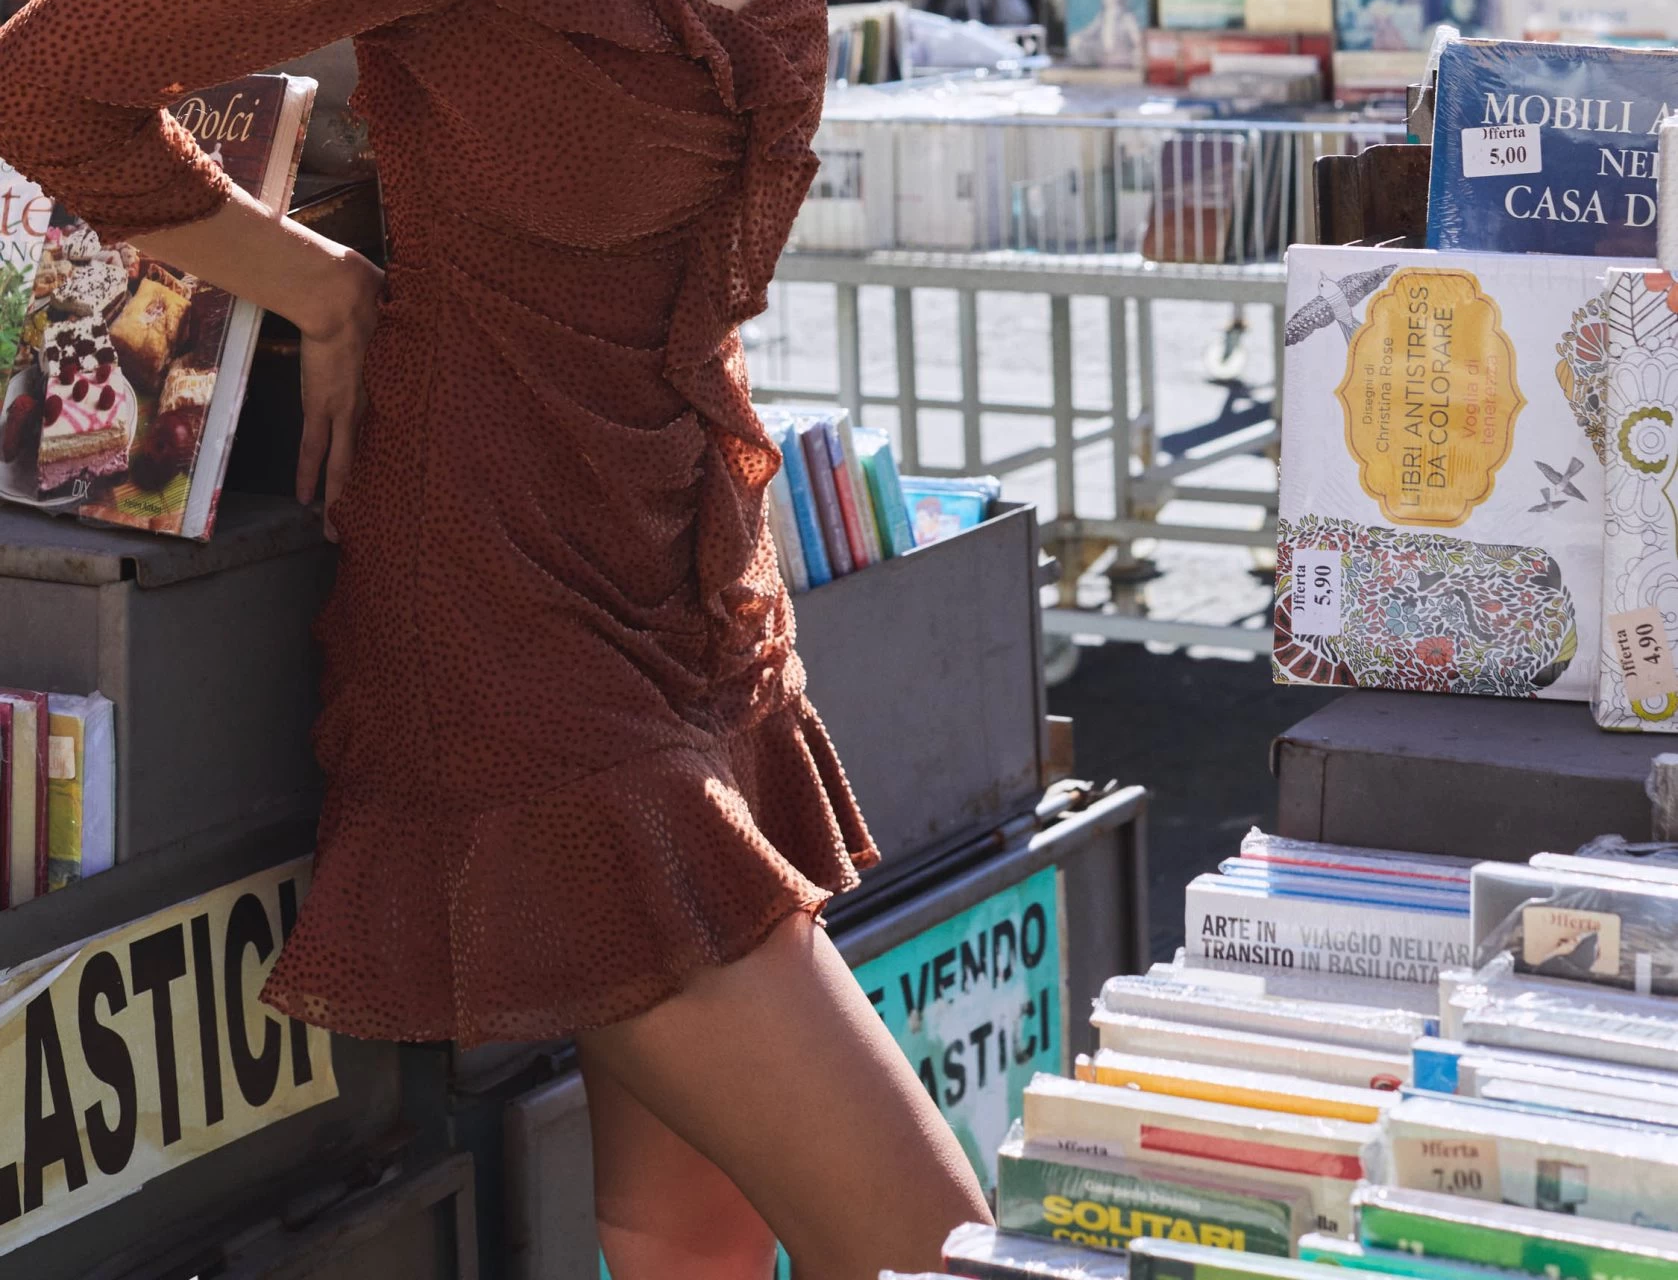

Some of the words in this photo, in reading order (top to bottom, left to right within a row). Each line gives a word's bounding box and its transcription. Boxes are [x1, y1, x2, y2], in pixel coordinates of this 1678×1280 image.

[175, 93, 261, 142] Dolci
[1481, 92, 1635, 134] MOBILI
[1489, 145, 1527, 168] 5,00
[1504, 185, 1608, 225] CASA
[1364, 363, 1375, 376] di
[1380, 337, 1394, 376] Rose
[1404, 286, 1429, 438] ANTISTRESS
[1428, 306, 1453, 445] COLORARE
[1466, 359, 1480, 376] di
[1362, 380, 1376, 425] Disegni
[1375, 382, 1392, 453] Christina
[1462, 381, 1481, 440] Voglia
[1480, 355, 1499, 446] tenerezza
[1401, 447, 1422, 507] LIBRI
[1427, 454, 1448, 488] DA
[1314, 565, 1334, 606] 5,90
[1635, 623, 1663, 665] 4,90
[1202, 914, 1250, 938] ARTE
[1257, 920, 1277, 944] IN
[1301, 925, 1382, 957] VIAGGIO
[901, 902, 1046, 1025] VENDO
[1202, 938, 1295, 969] TRANSITO
[1301, 951, 1321, 971] IN
[1328, 954, 1440, 985] BASILICATA
[1432, 1168, 1483, 1194] 7,00
[1043, 1194, 1246, 1253] SOLITARI
